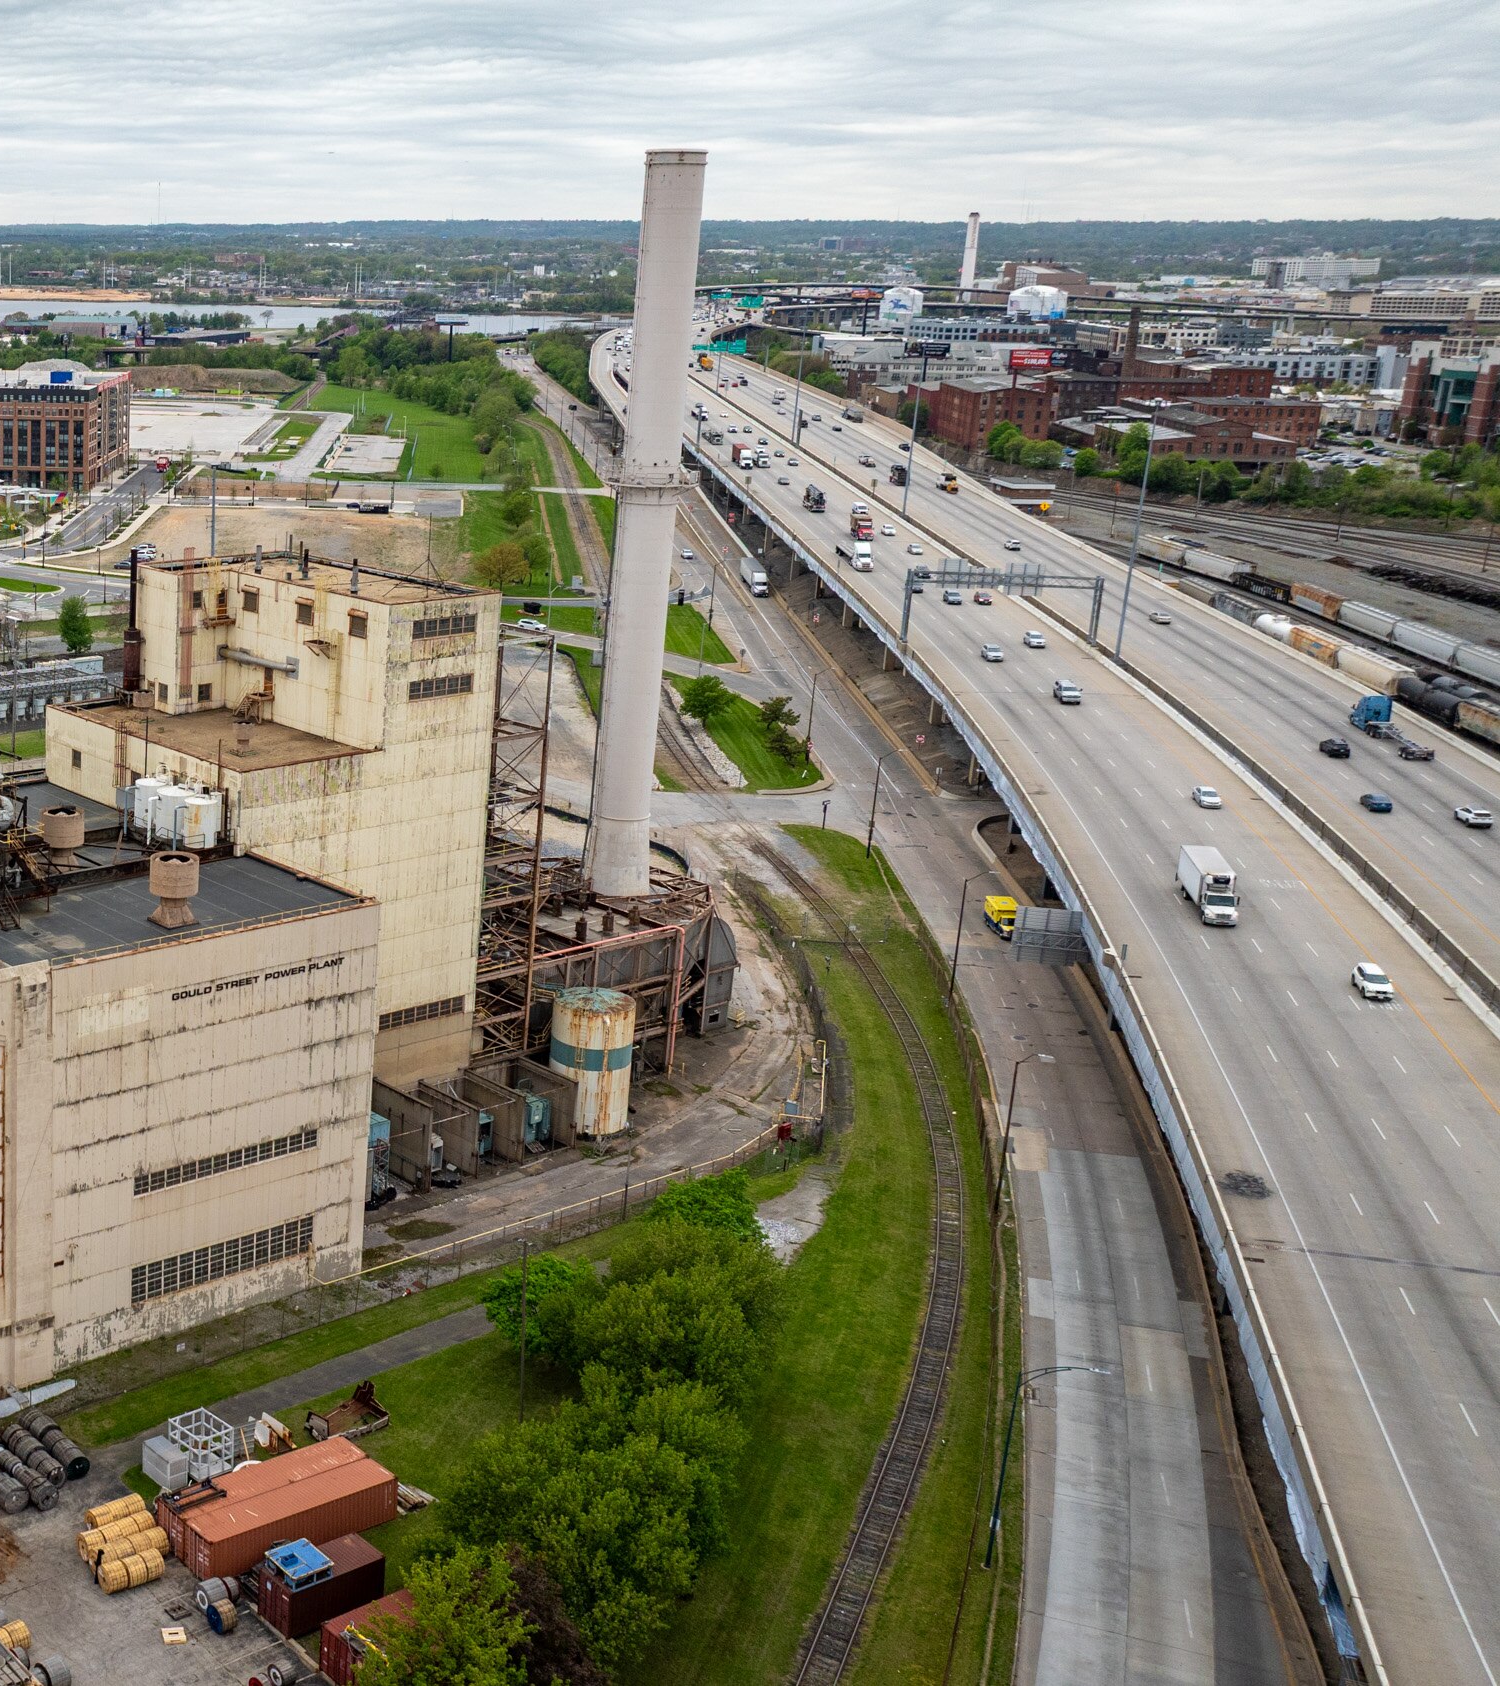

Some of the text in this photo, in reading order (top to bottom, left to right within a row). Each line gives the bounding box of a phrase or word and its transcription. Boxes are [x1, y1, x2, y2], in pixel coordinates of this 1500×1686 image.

[171, 956, 346, 1001] GOULD STREET POWER PLANT
